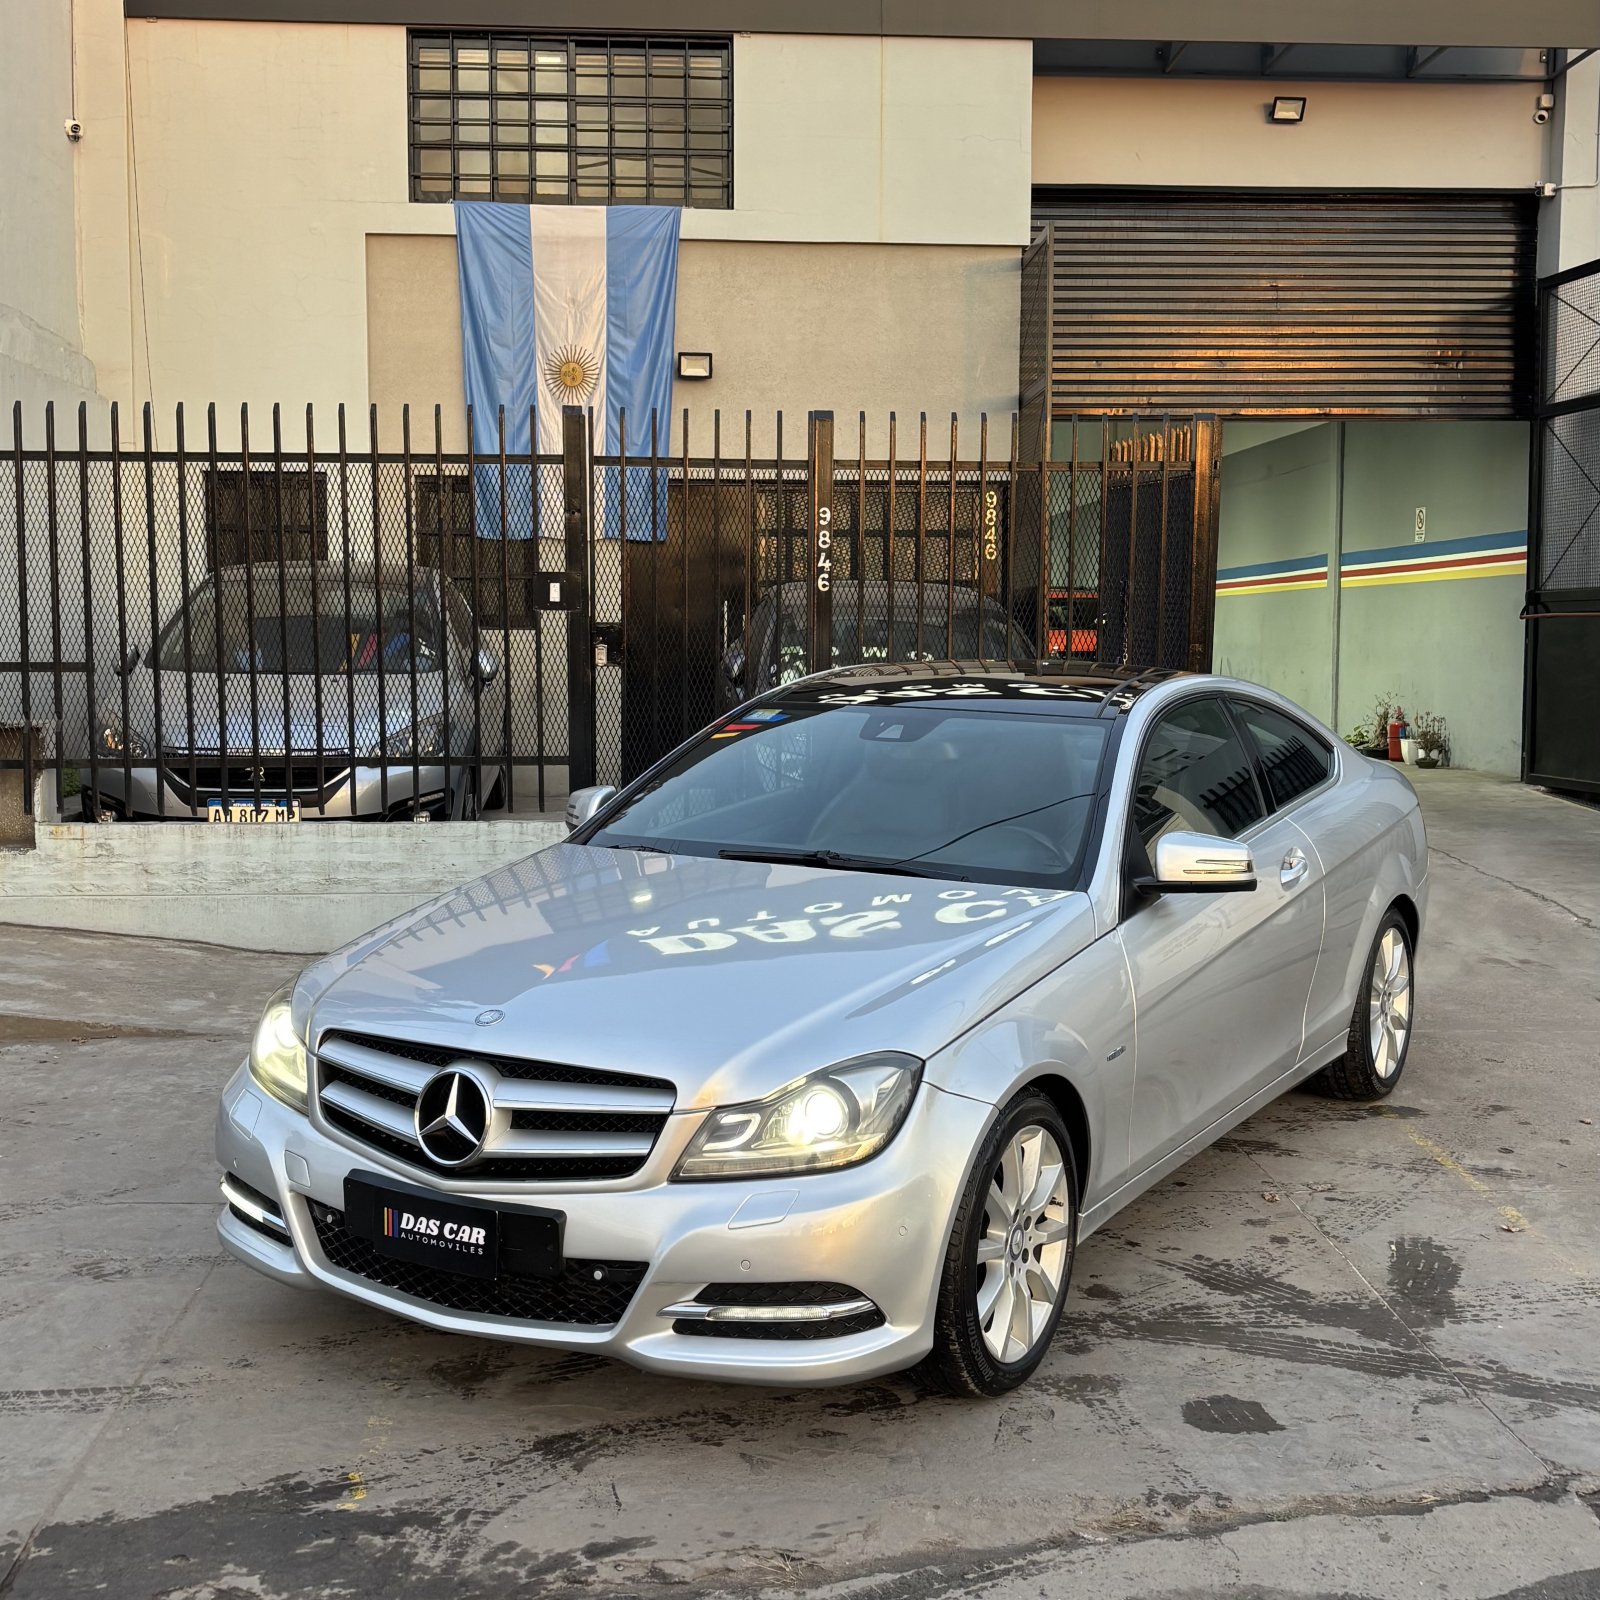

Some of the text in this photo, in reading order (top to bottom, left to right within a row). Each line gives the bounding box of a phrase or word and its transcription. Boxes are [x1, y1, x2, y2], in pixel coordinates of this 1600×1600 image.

[818, 507, 832, 592] 9846
[984, 491, 997, 560] 9846
[400, 1212, 487, 1245] DAS CAR
[400, 1232, 484, 1255] AUTOMOVILES
